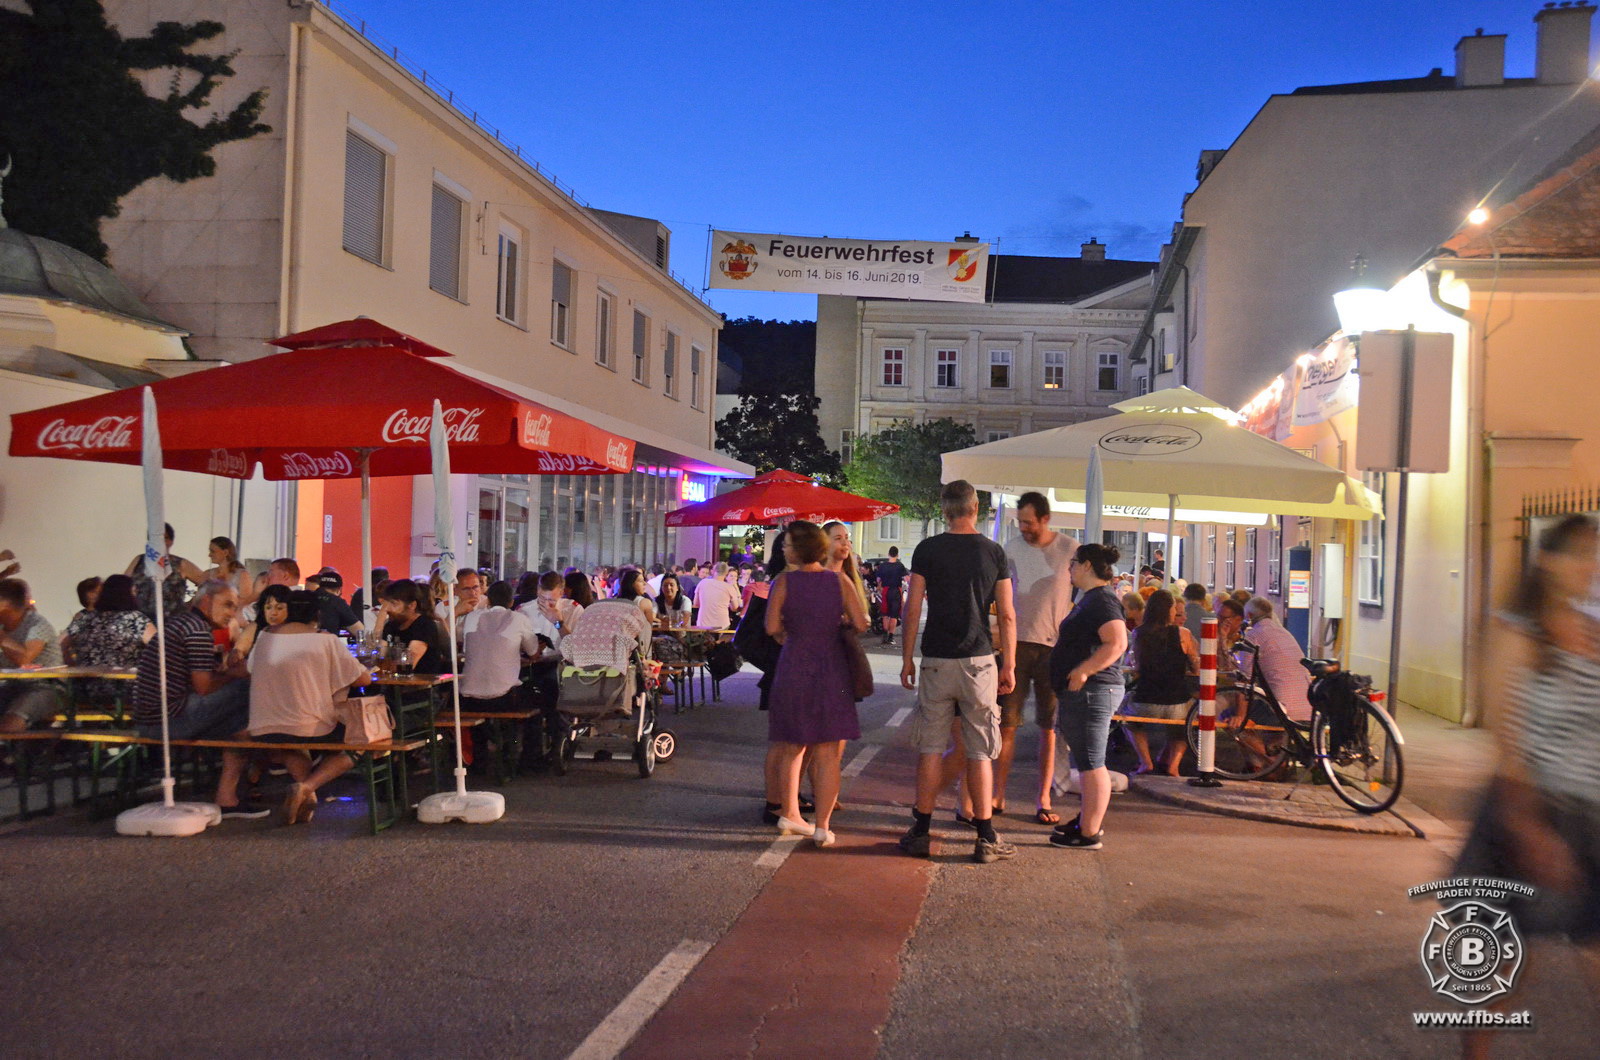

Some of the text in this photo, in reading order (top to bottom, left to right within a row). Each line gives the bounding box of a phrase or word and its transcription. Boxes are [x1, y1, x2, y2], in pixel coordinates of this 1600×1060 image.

[768, 240, 935, 265] Feuerwehrfest
[777, 268, 922, 284] vom 14. bis 16. Juni 2019.
